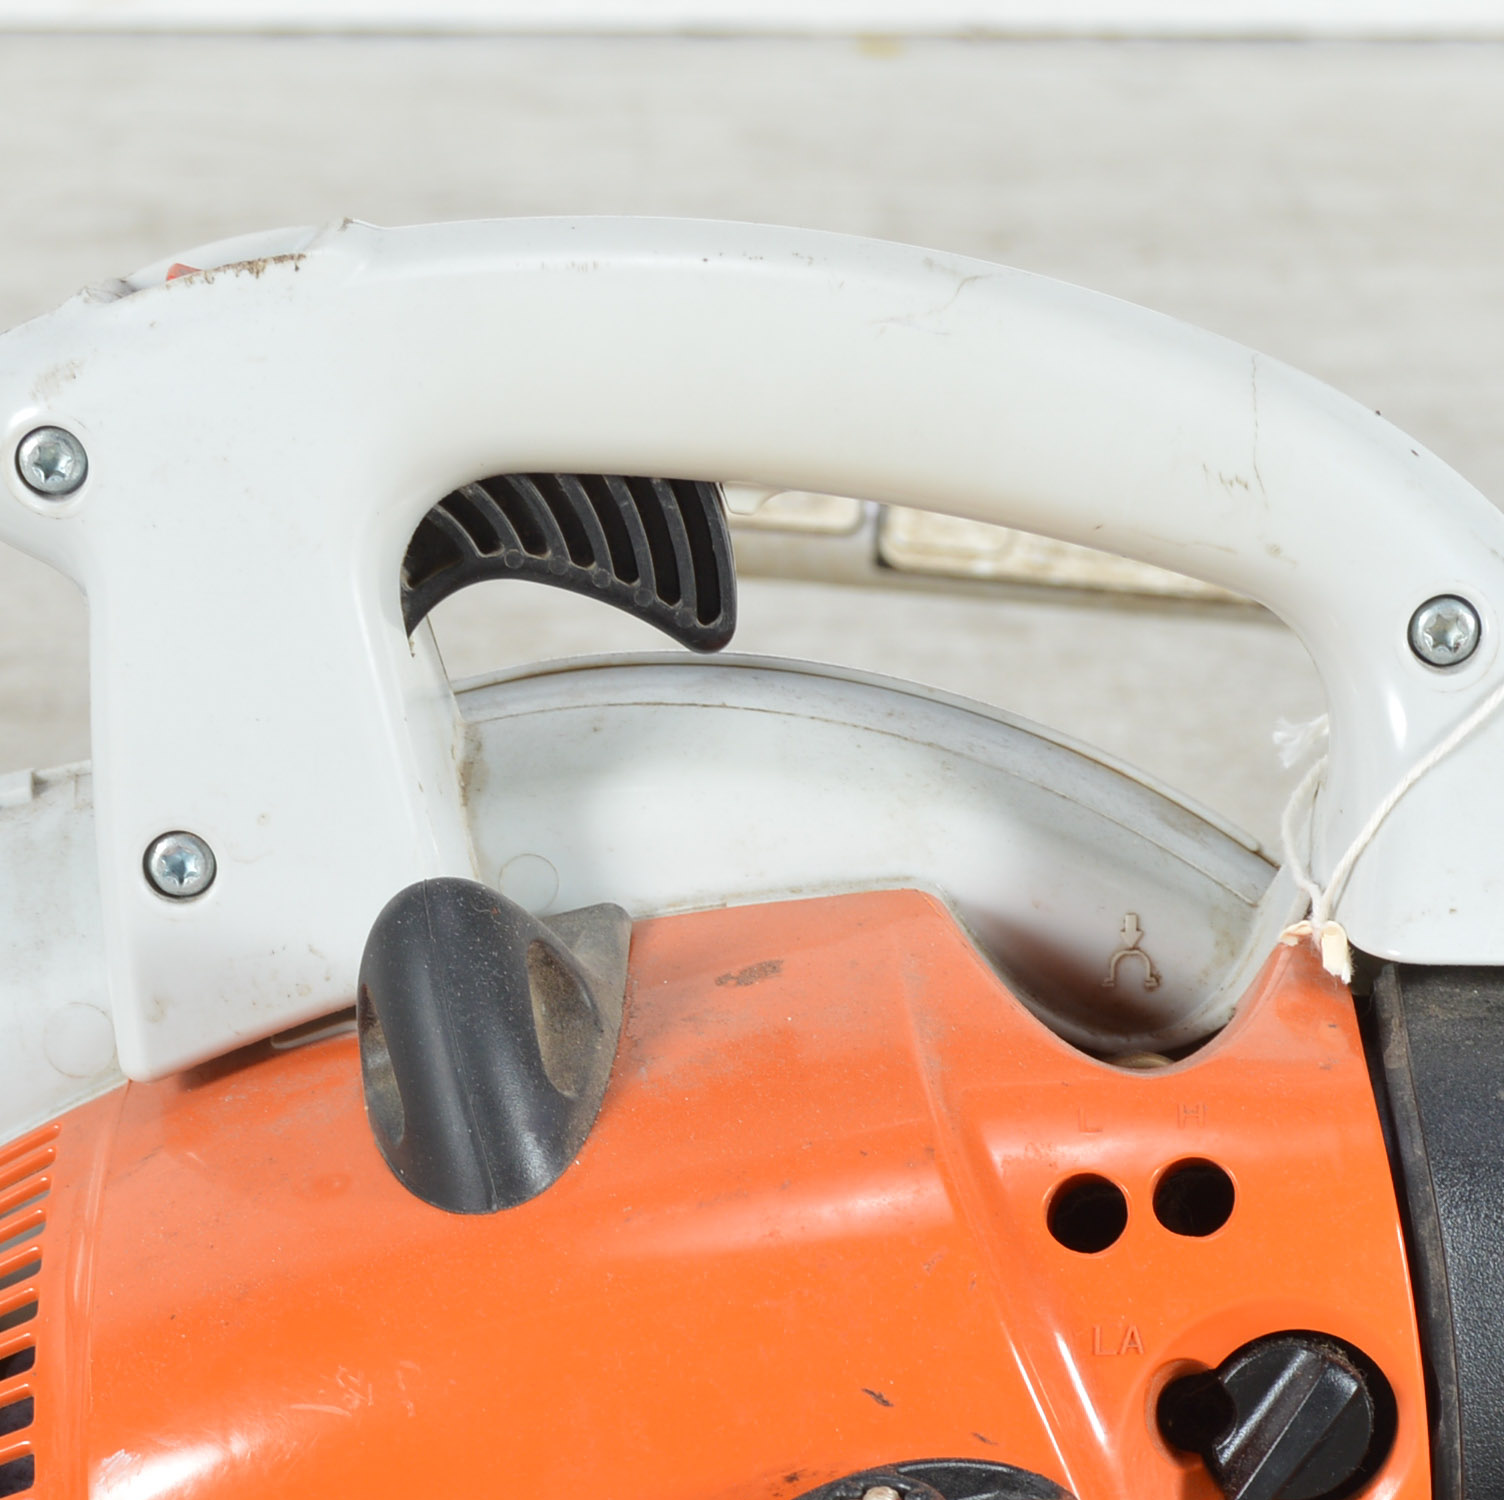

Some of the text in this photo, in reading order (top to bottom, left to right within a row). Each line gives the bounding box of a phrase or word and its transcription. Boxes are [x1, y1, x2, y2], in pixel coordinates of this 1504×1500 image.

[1077, 1102, 1207, 1135] L H
[1092, 1324, 1145, 1356] LA
